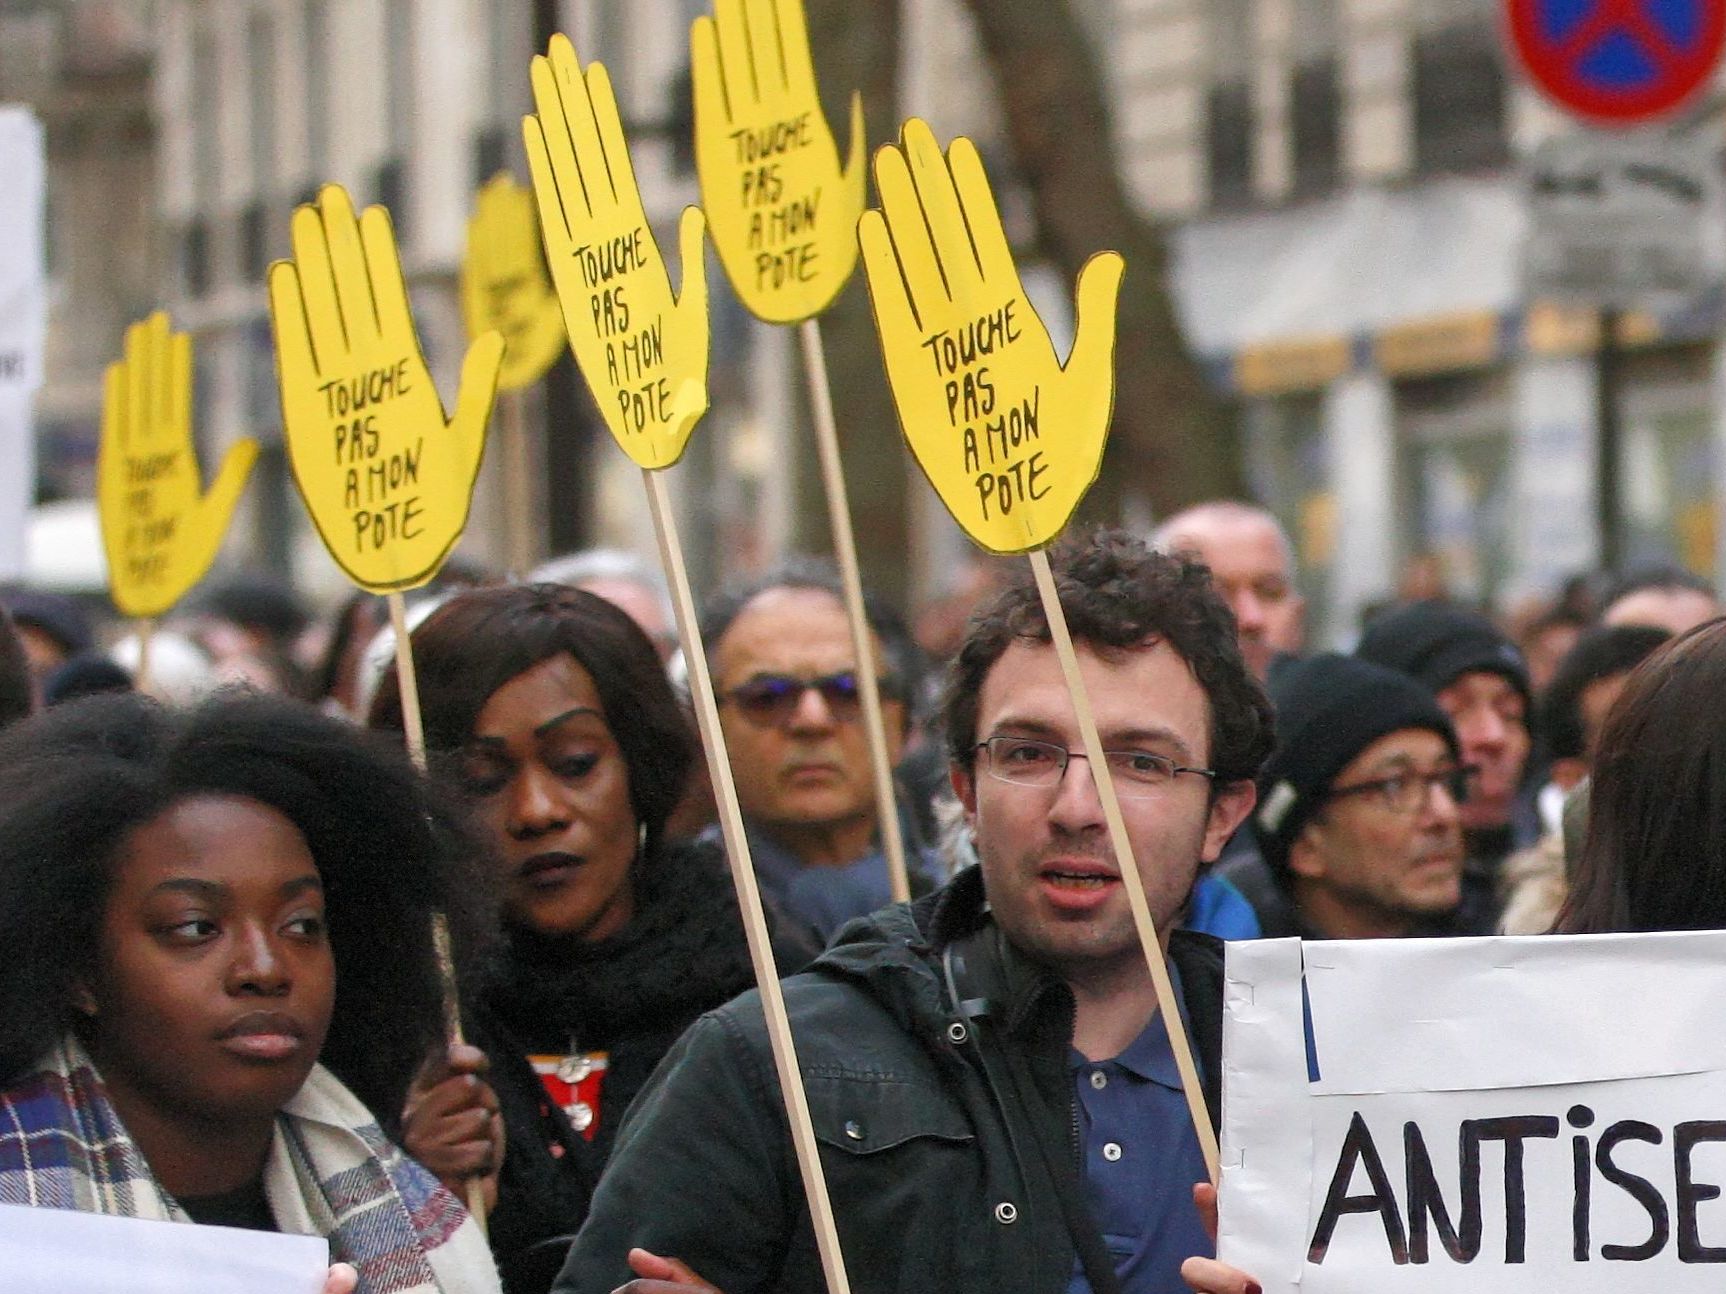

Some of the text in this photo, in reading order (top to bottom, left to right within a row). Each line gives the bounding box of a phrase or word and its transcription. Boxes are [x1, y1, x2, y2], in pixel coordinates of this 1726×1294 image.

[729, 112, 812, 164] TOUCHE
[742, 164, 782, 209] PAS
[572, 227, 647, 288] TOUCHE
[756, 242, 819, 292] POTE
[591, 286, 629, 339] PAS
[921, 299, 1022, 376] TOUCHE
[606, 314, 663, 386] A MON
[317, 357, 412, 418] TOUCHE
[618, 378, 674, 435] POTE
[946, 367, 995, 427] PAS
[335, 415, 379, 465] PAS
[964, 385, 1039, 474] A MON
[345, 437, 423, 509] A MON
[975, 451, 1052, 521] POTE
[353, 496, 425, 553] POTE
